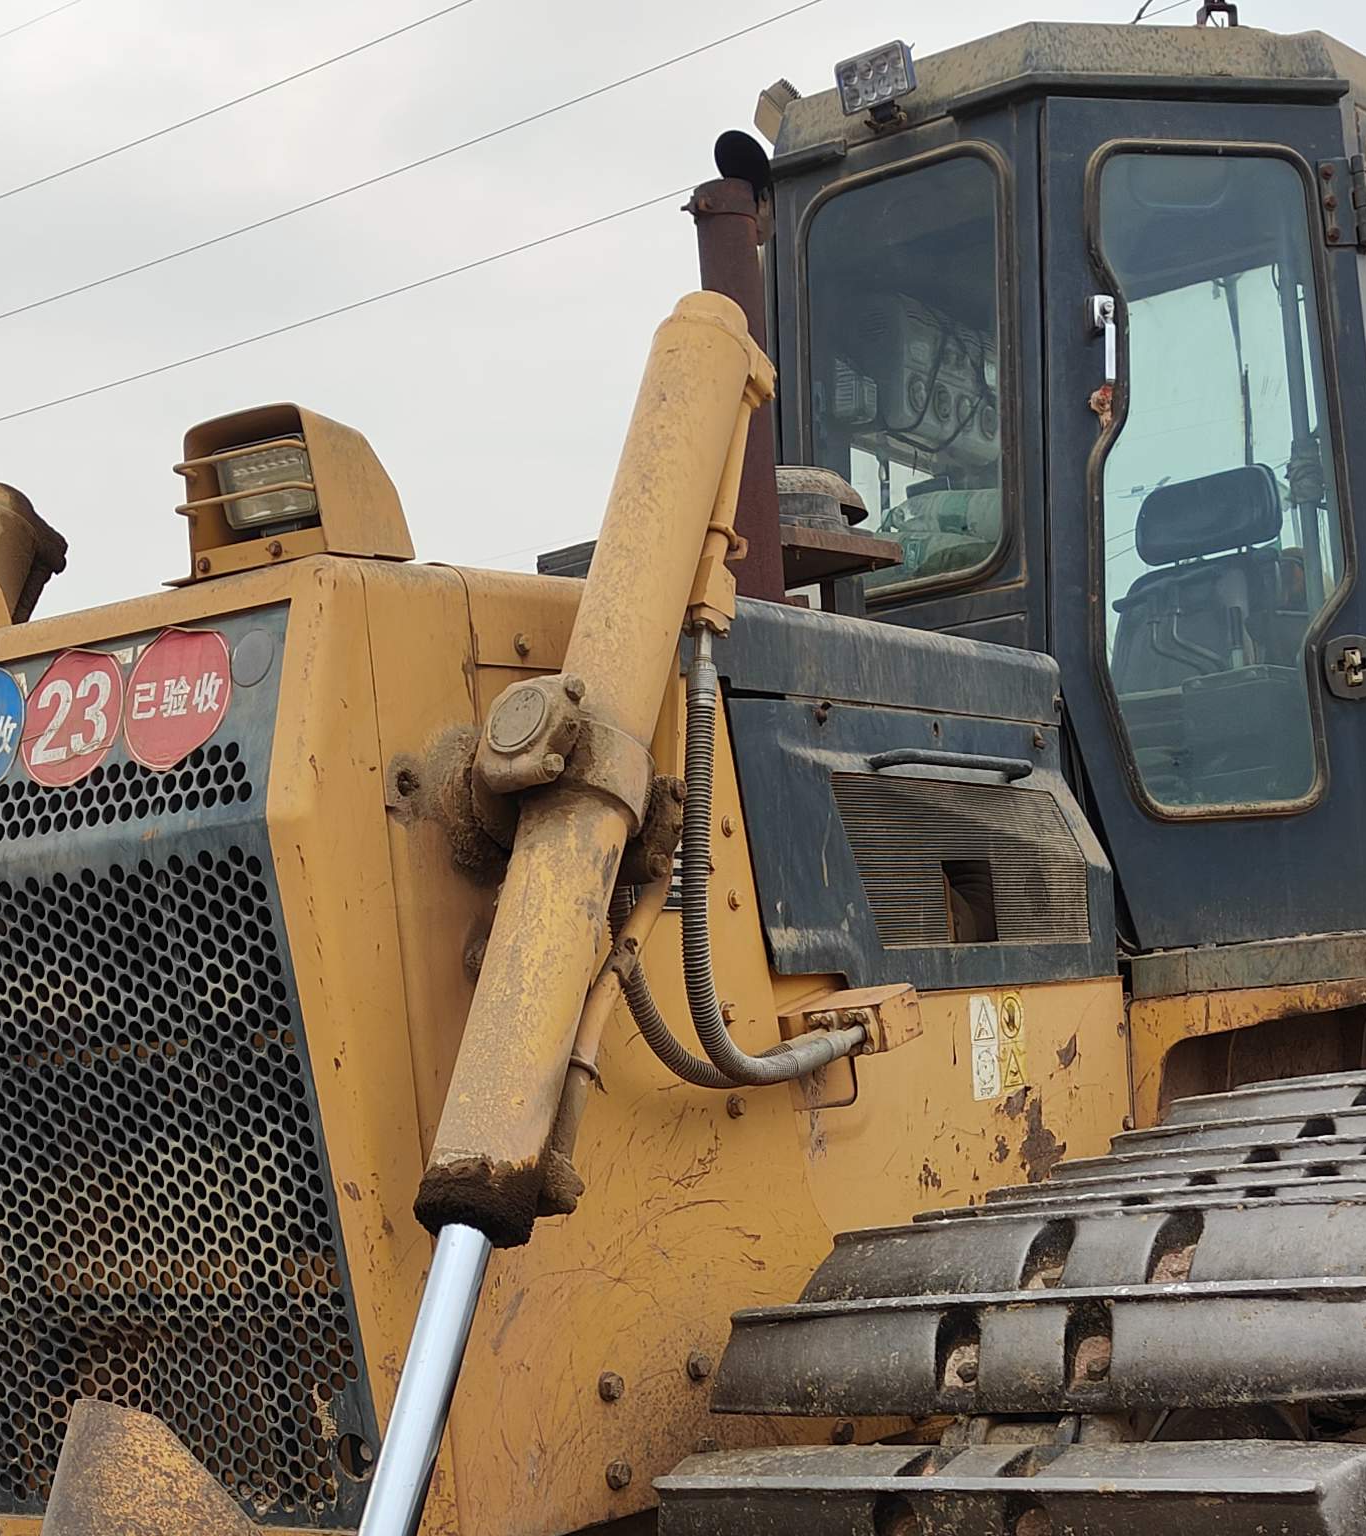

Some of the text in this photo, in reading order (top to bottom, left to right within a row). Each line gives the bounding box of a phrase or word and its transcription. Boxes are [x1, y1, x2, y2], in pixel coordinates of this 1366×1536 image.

[31, 670, 112, 765] 23
[133, 671, 223, 720] 已验收
